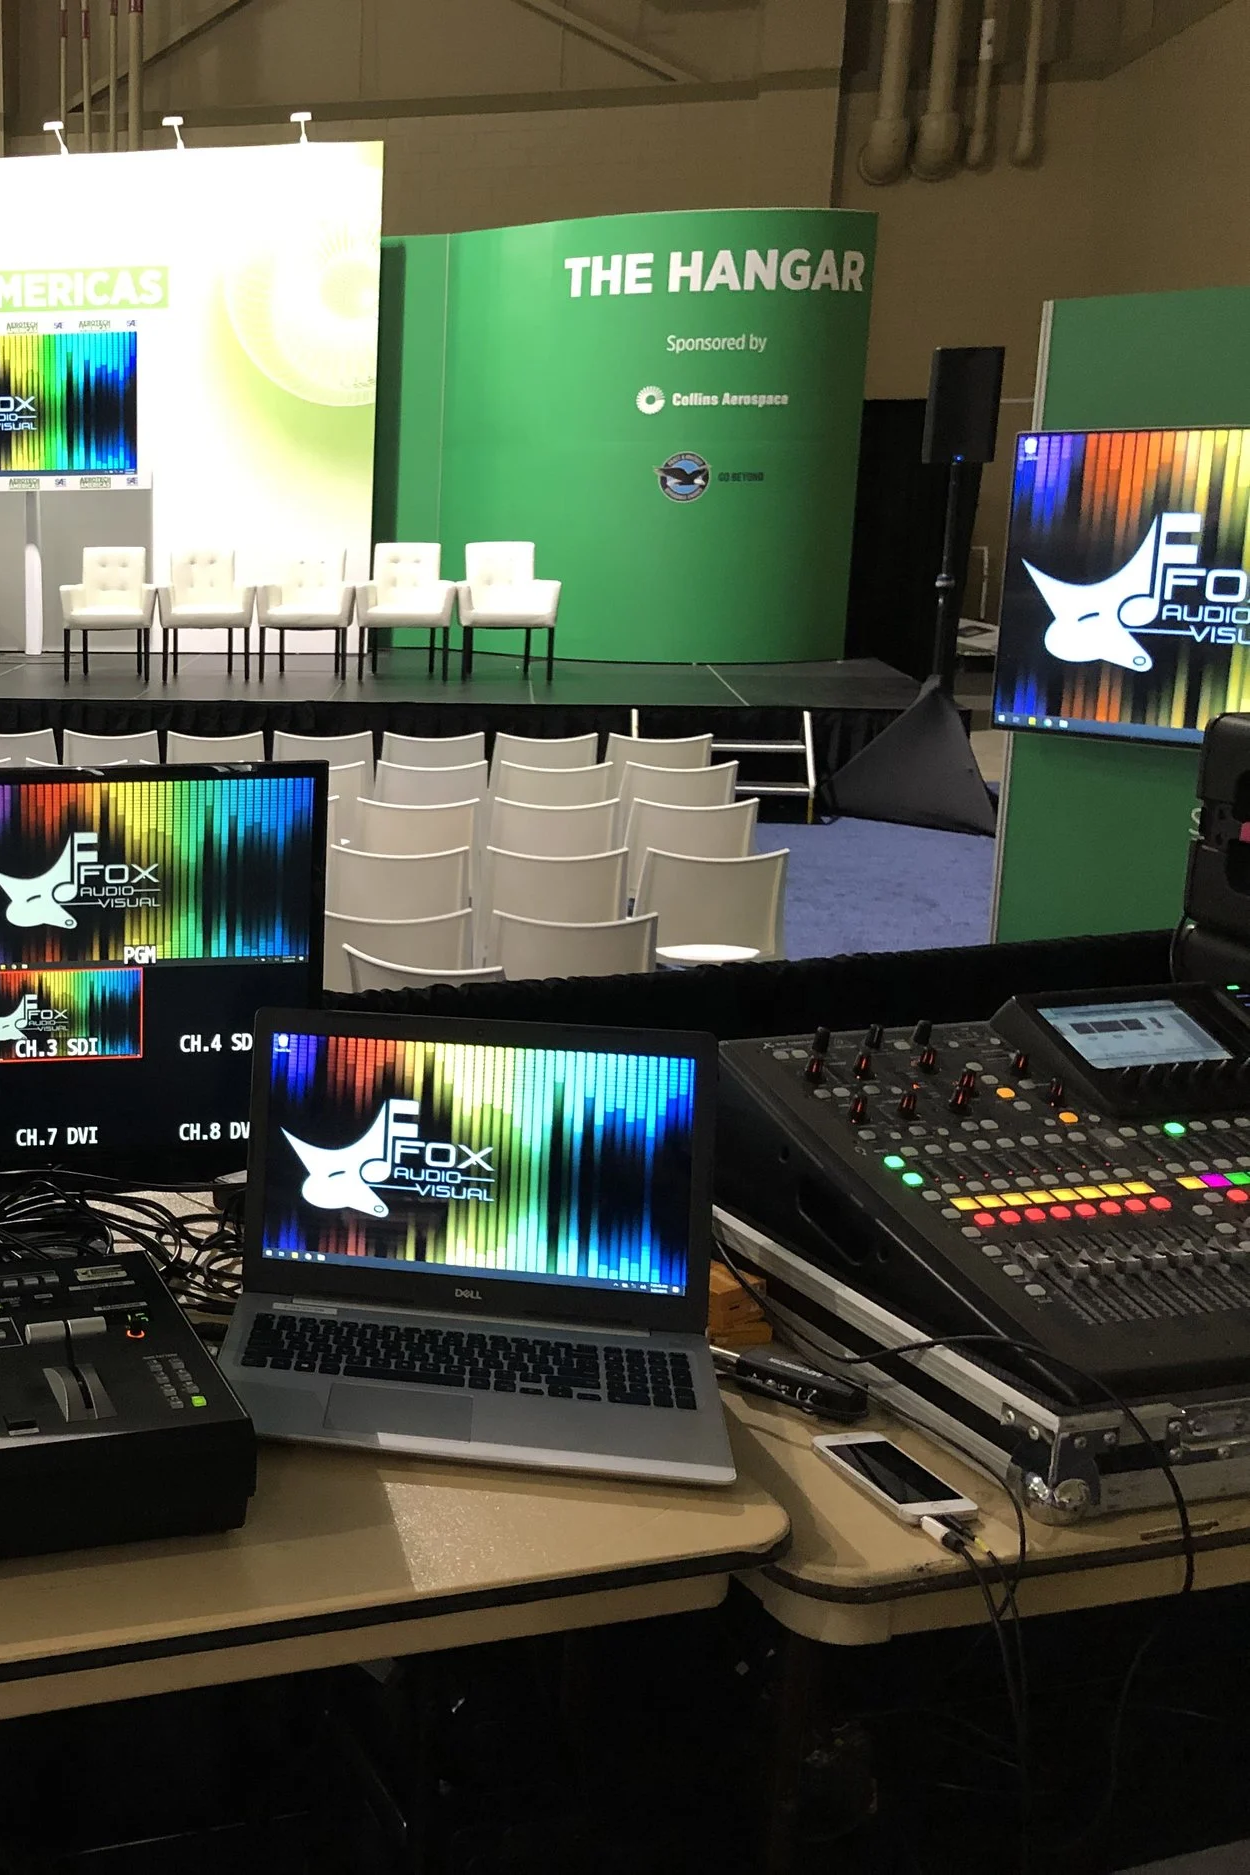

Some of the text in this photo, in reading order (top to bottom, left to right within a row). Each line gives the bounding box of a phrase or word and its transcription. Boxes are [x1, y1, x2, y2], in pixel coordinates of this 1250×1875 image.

[564, 248, 866, 298] THE HANGAR
[666, 333, 768, 354] Sponsored by
[672, 392, 789, 408] Collins Aerospace
[1163, 568, 1250, 603] FO
[79, 863, 160, 885] FOX
[79, 885, 134, 897] AUDIO
[97, 897, 161, 909] VISUAL
[123, 945, 157, 965] PGM
[27, 1008, 69, 1020] FOX
[14, 1037, 98, 1058] CH.3 SDI
[179, 1032, 253, 1053] CH.4 SD
[15, 1126, 98, 1147] CH.7 DVI
[178, 1121, 250, 1141] CH.8 DV
[393, 1140, 495, 1171] FOX
[392, 1167, 462, 1184] AUDIO
[415, 1183, 495, 1202] VISUAL
[454, 1287, 483, 1301] DELL
